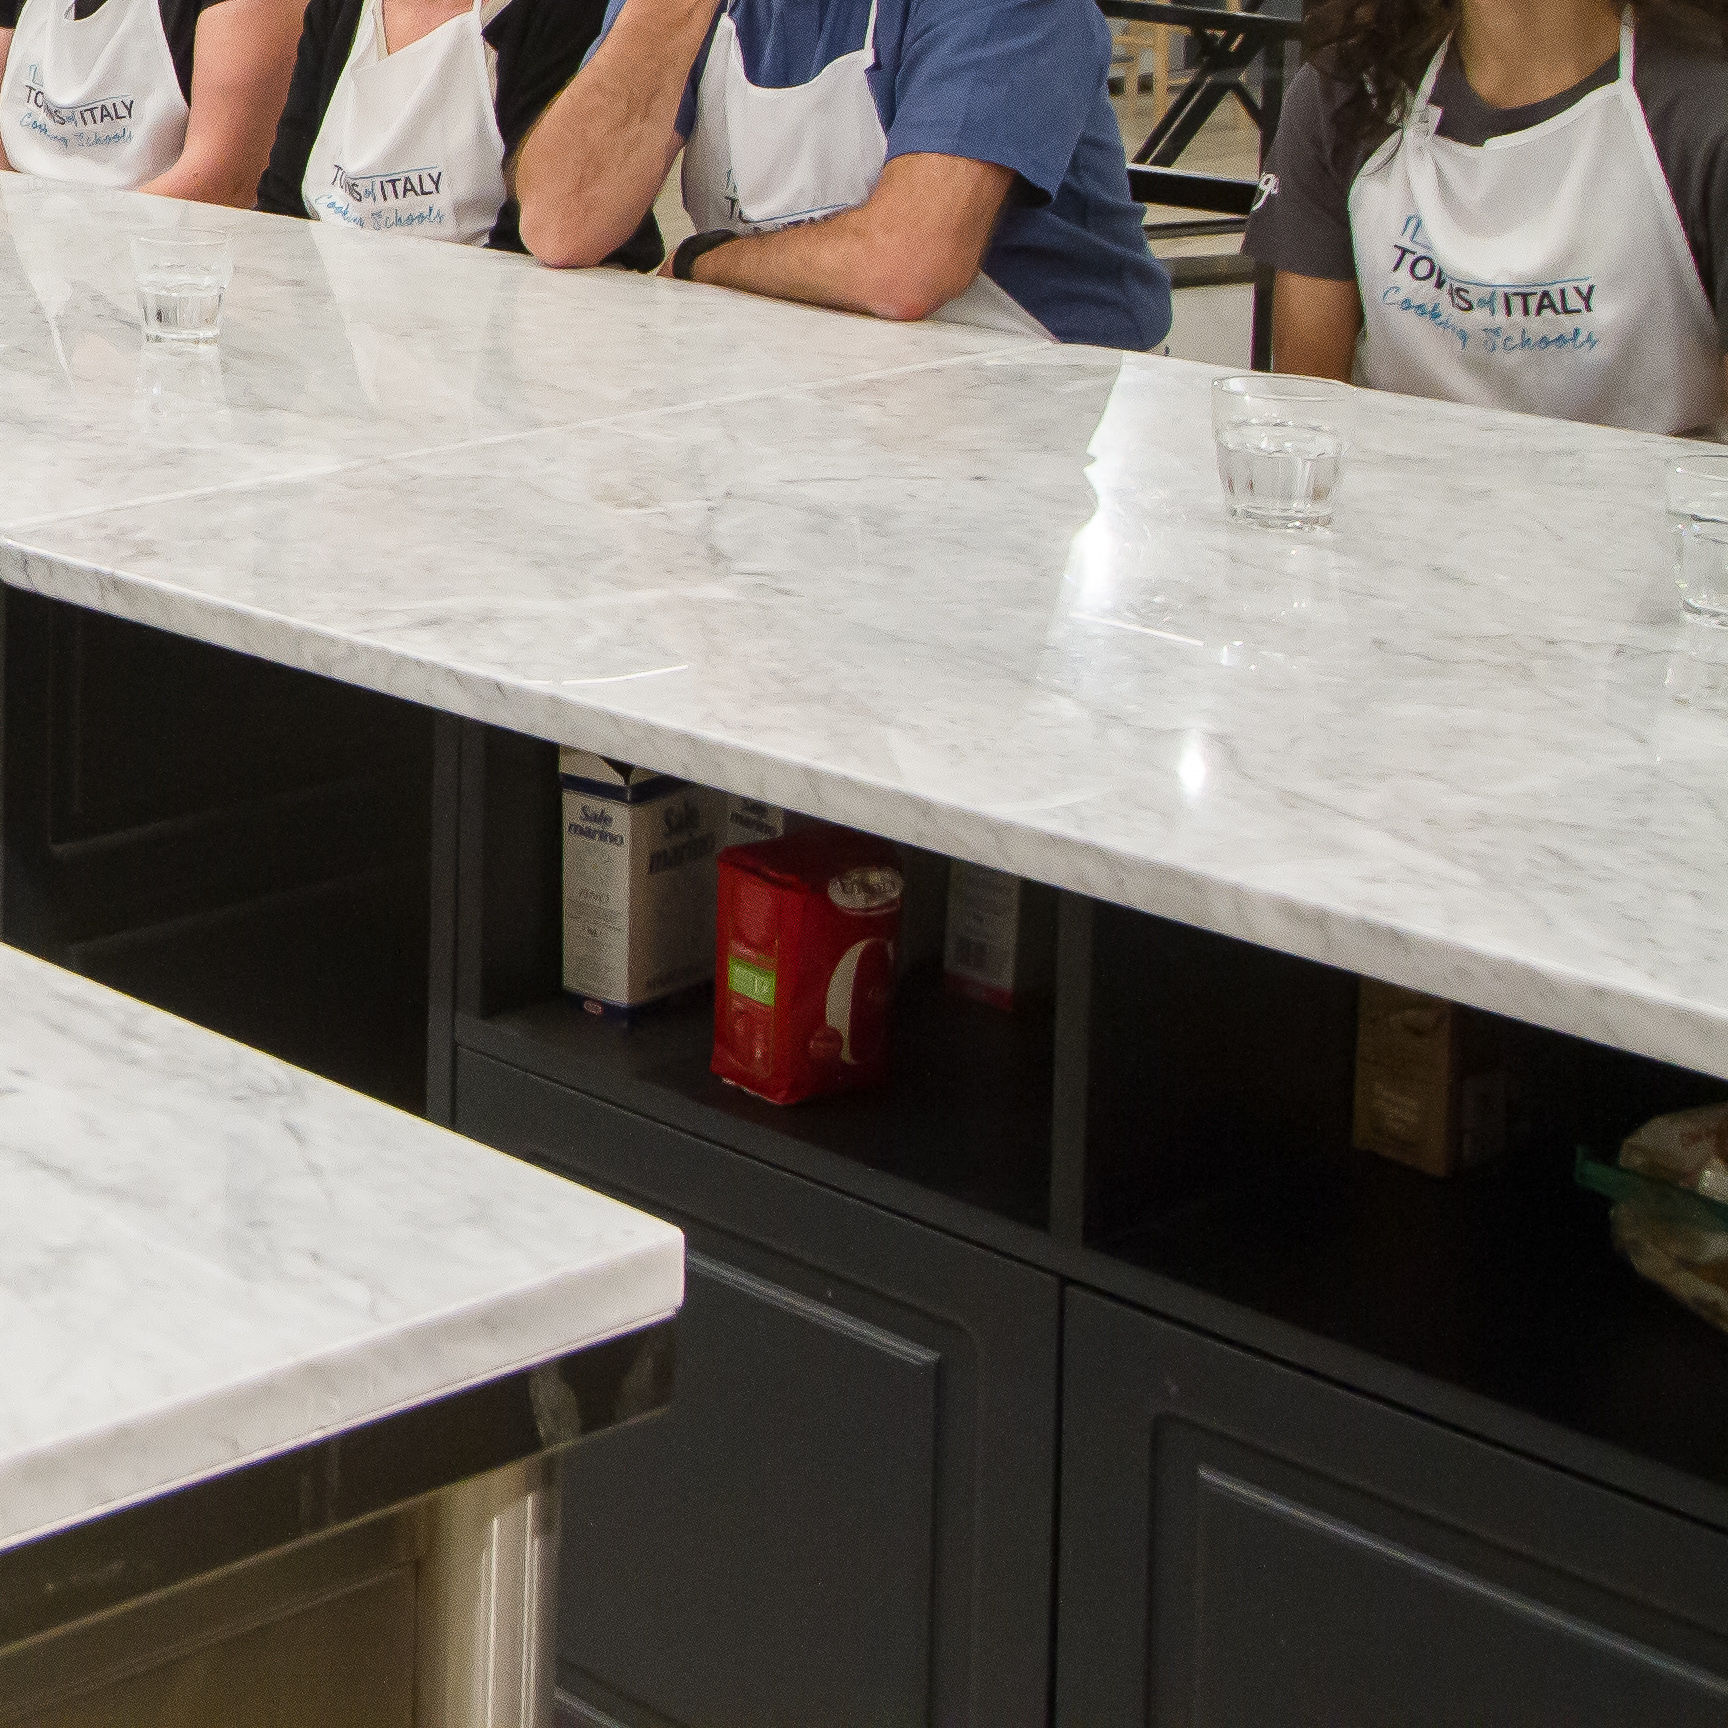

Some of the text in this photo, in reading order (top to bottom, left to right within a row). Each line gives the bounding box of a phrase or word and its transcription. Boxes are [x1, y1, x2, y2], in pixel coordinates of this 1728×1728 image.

[79, 100, 134, 126] ITALY
[379, 171, 442, 202] ITALY
[1503, 284, 1596, 318] ITALY
[580, 804, 614, 827] Sale
[567, 823, 624, 846] marino
